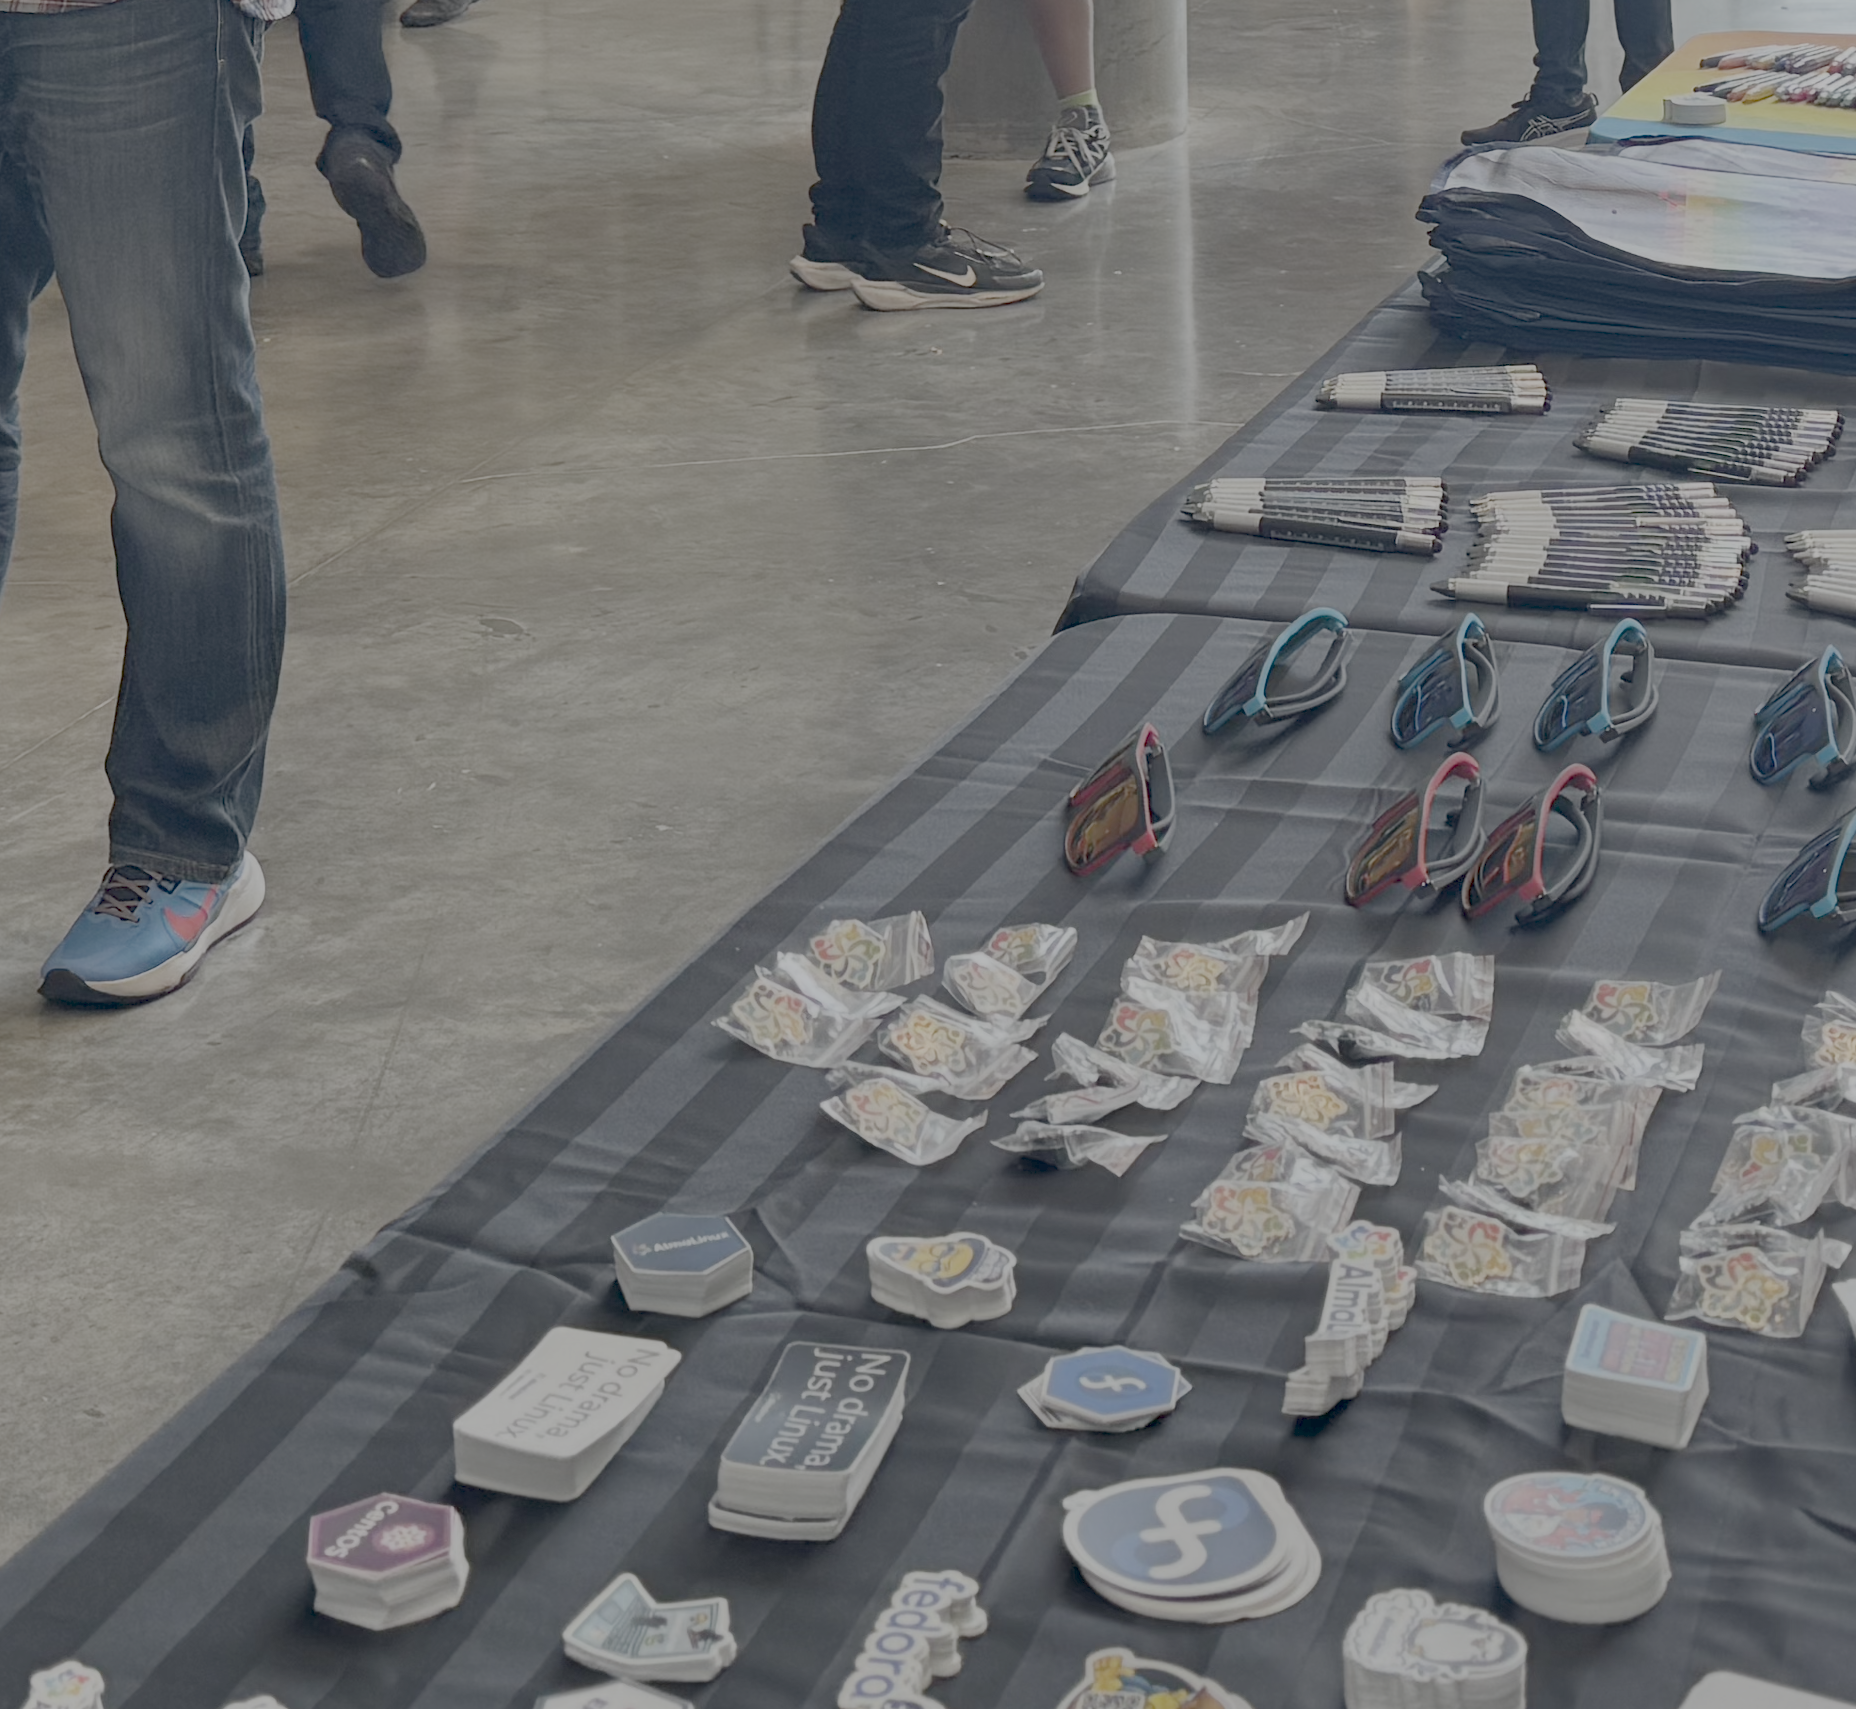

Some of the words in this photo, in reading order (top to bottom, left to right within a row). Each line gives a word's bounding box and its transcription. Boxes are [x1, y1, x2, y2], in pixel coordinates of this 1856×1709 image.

[653, 1229, 731, 1254] AlmaLinux
[558, 1350, 616, 1391] just
[616, 1348, 661, 1379] No
[800, 1347, 853, 1402] just
[849, 1353, 892, 1393] No
[496, 1392, 573, 1438] Linux
[535, 1381, 623, 1439] drama,
[759, 1404, 826, 1466] Linux
[794, 1397, 869, 1471] drama,
[323, 1500, 400, 1559] CentOS
[850, 1577, 966, 1699] fedora
